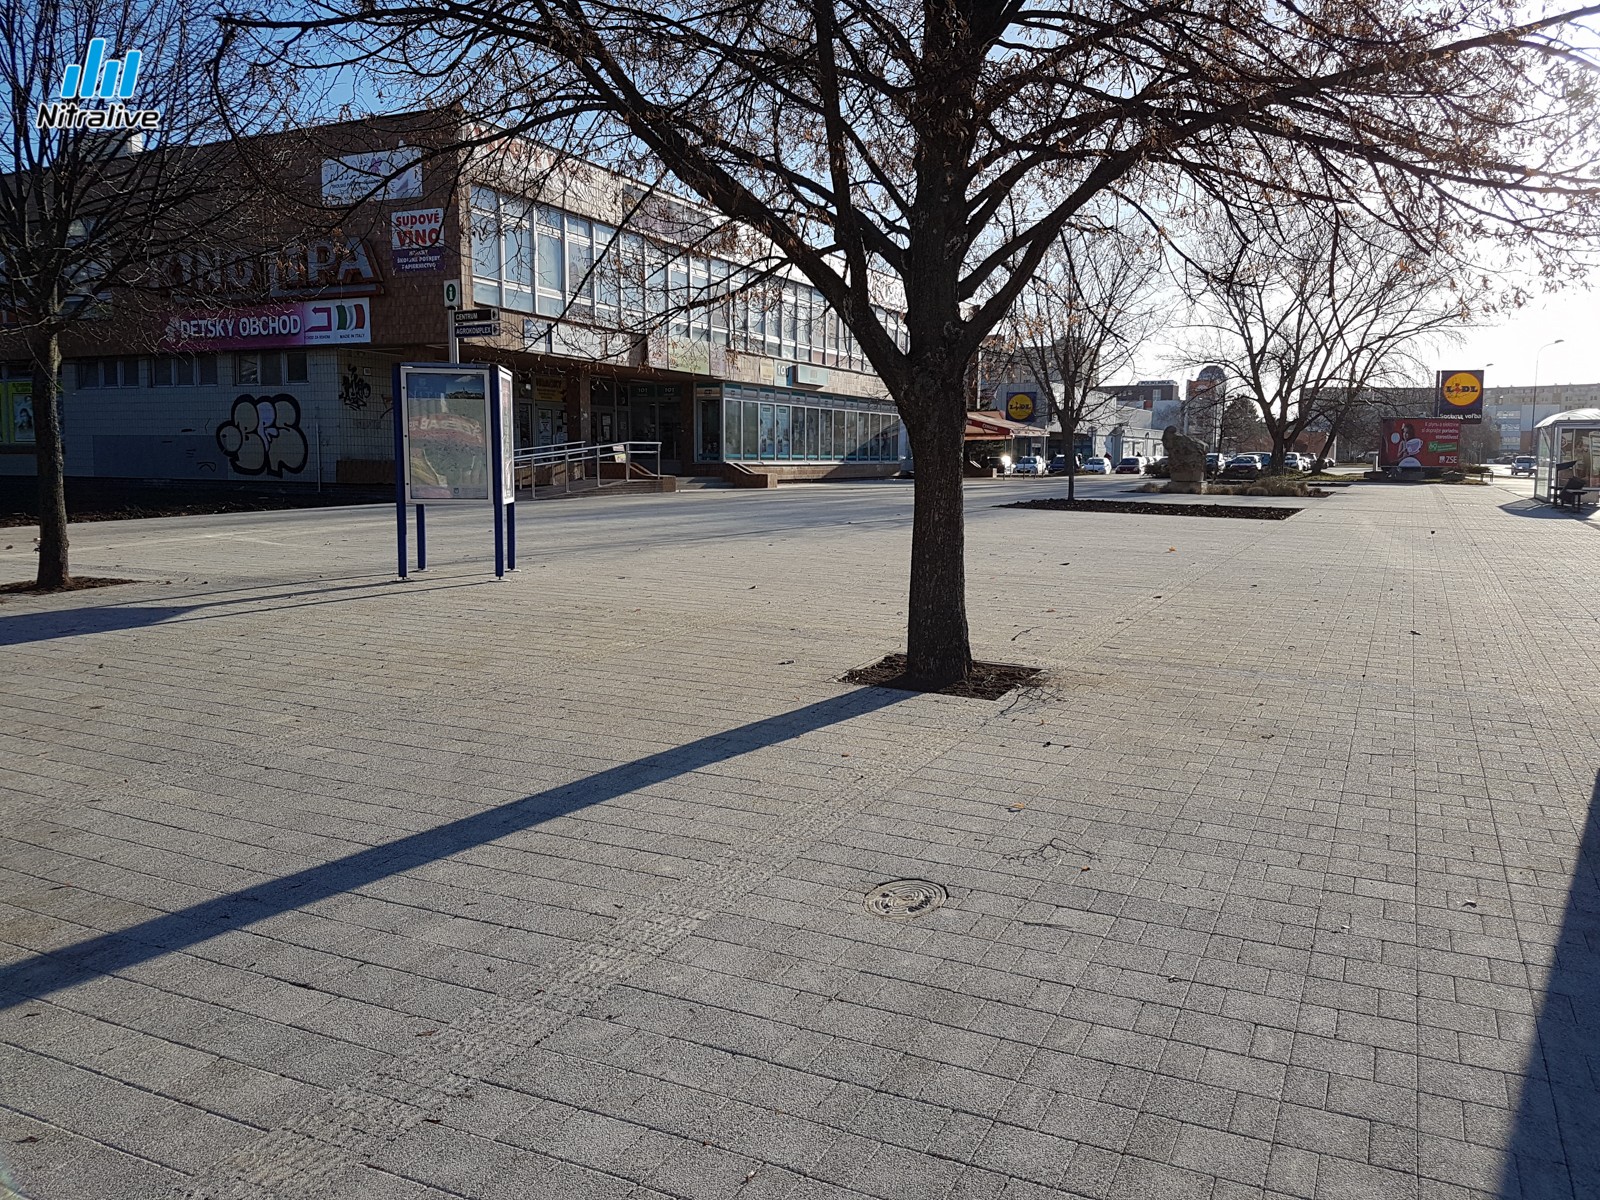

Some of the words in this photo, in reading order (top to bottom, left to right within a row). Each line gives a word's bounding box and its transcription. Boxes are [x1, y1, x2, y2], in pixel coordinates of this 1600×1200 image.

[395, 210, 439, 226] SUDOVÉ
[396, 226, 439, 246] VÍNO
[239, 314, 301, 337] OBCHOD
[456, 326, 491, 335] AGROKOMPLEX
